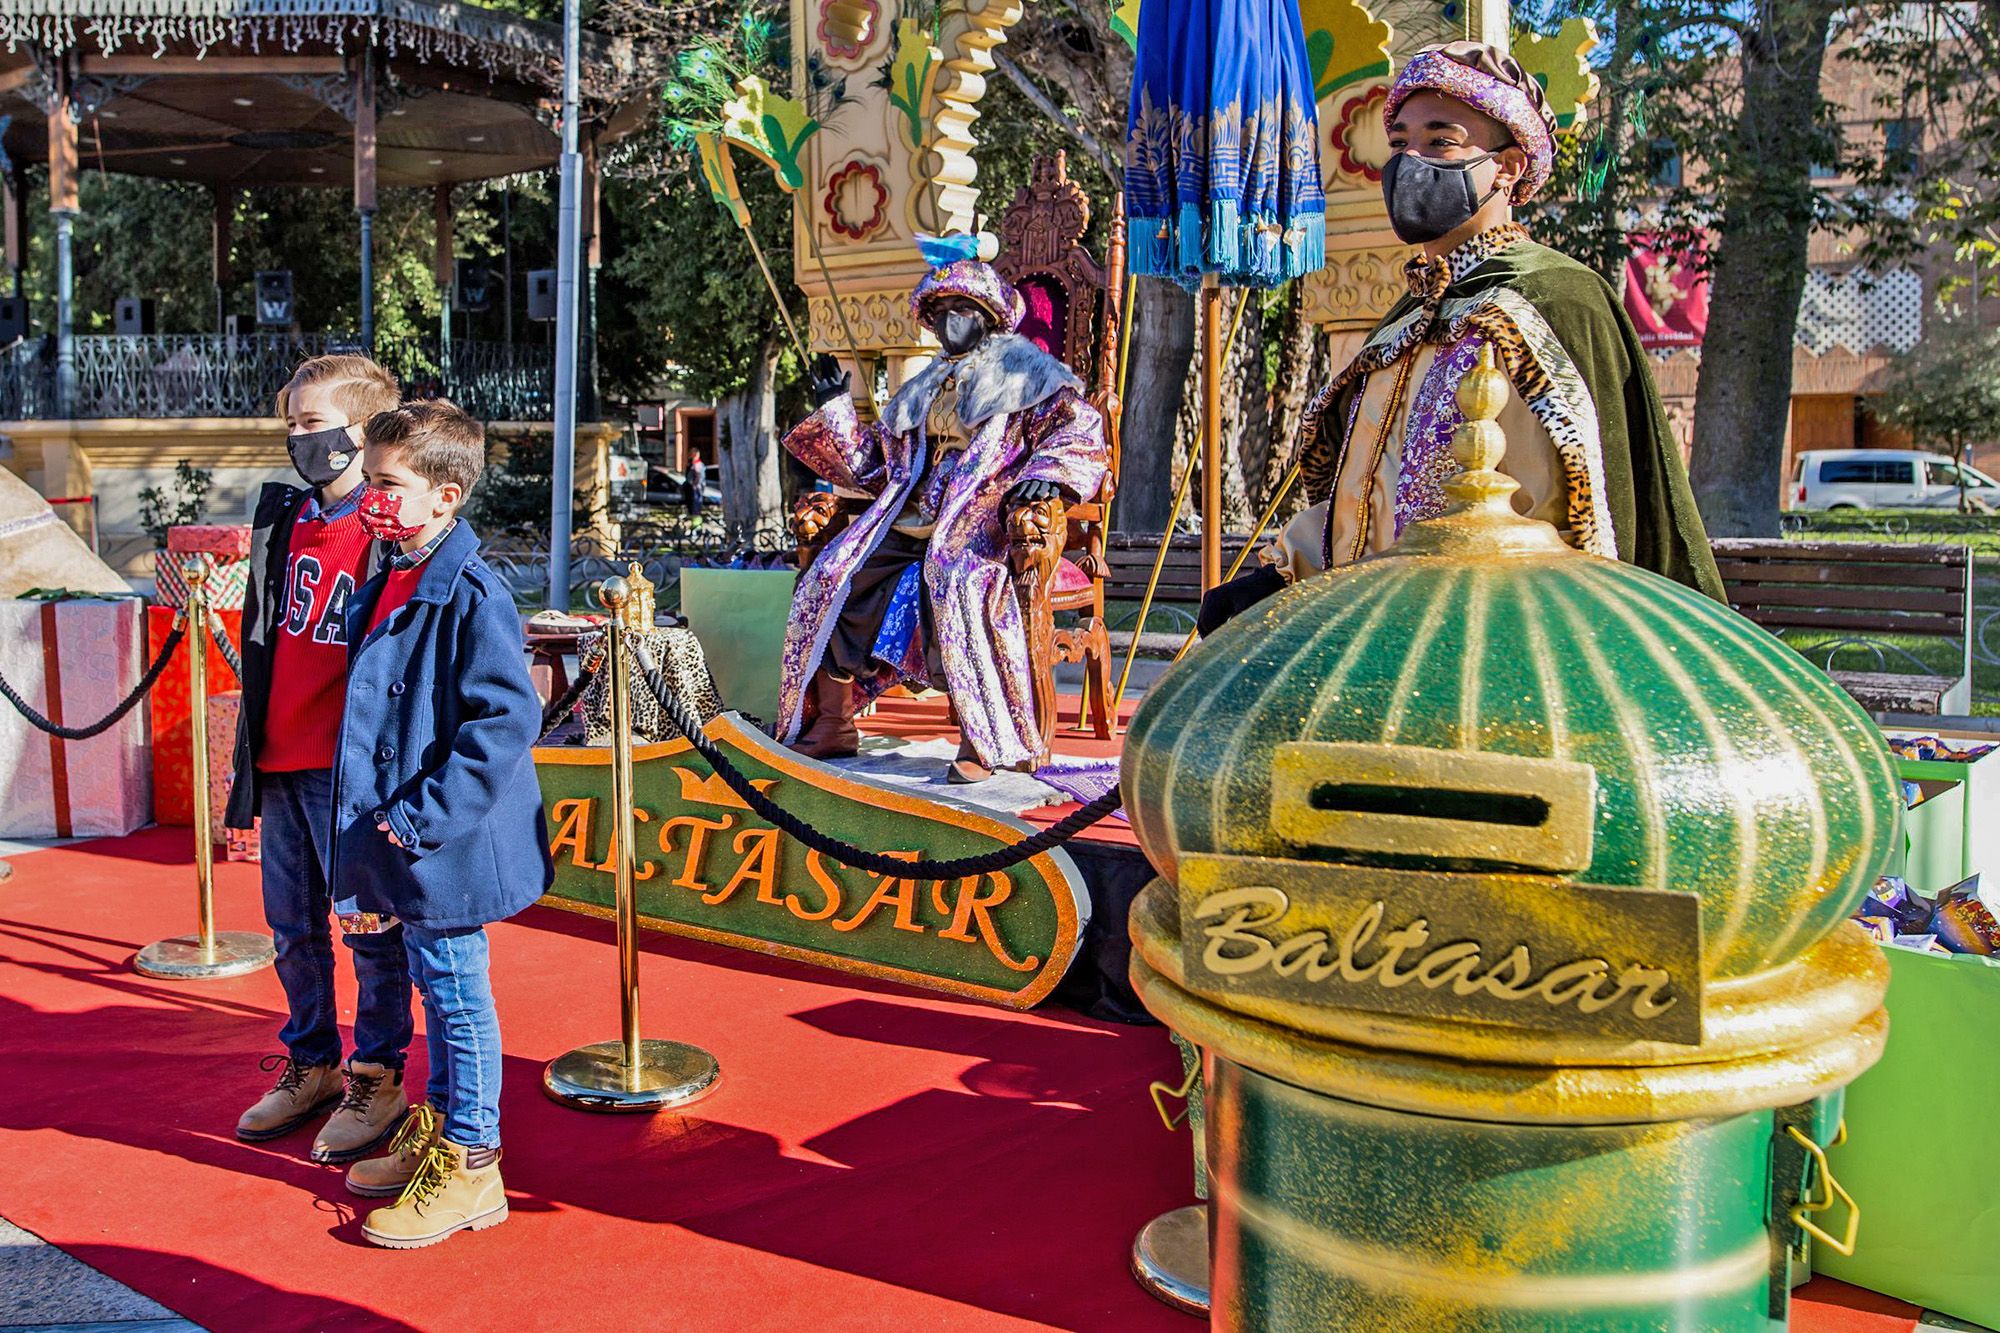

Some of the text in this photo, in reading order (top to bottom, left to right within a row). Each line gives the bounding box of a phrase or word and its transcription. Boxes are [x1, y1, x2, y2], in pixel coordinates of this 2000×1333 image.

[262, 301, 288, 318] W
[549, 797, 1040, 972] ALTASAR
[1193, 885, 1678, 1020] Baltasar
